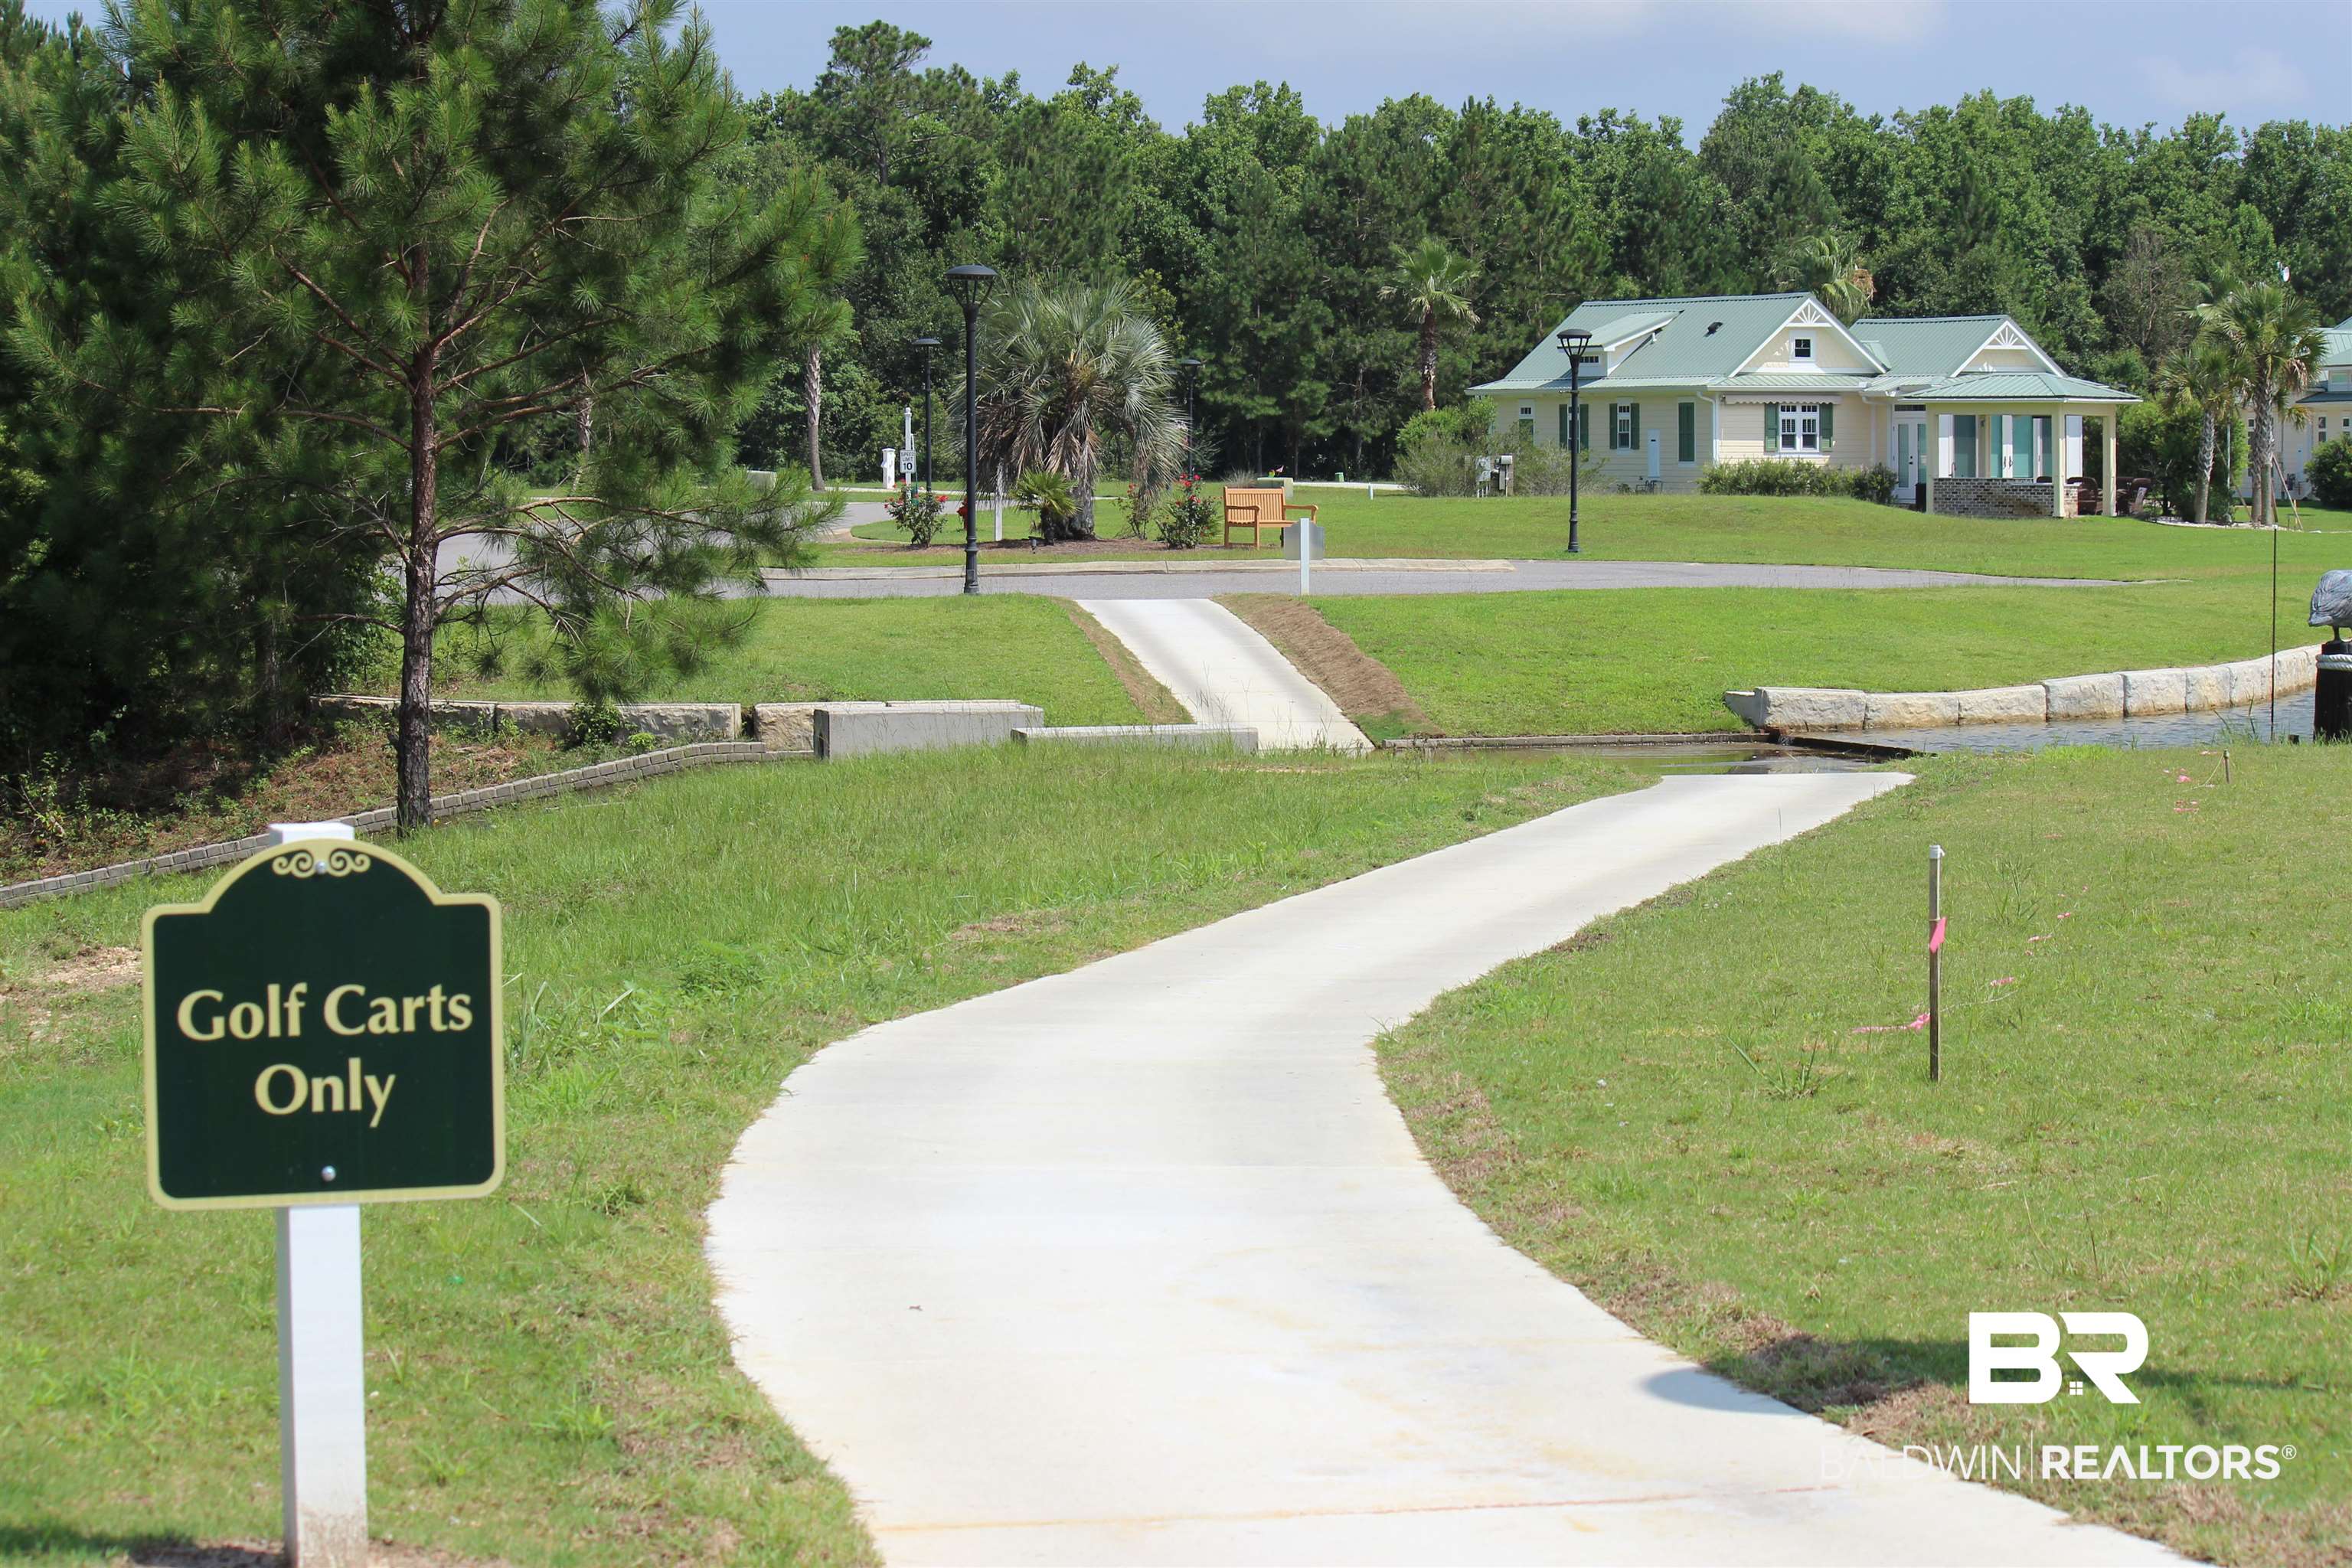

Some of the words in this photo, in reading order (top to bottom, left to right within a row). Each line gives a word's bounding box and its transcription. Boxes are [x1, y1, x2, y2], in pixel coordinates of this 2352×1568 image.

[178, 982, 308, 1041] Golf
[324, 984, 473, 1036] Carts
[254, 1057, 396, 1128] Only
